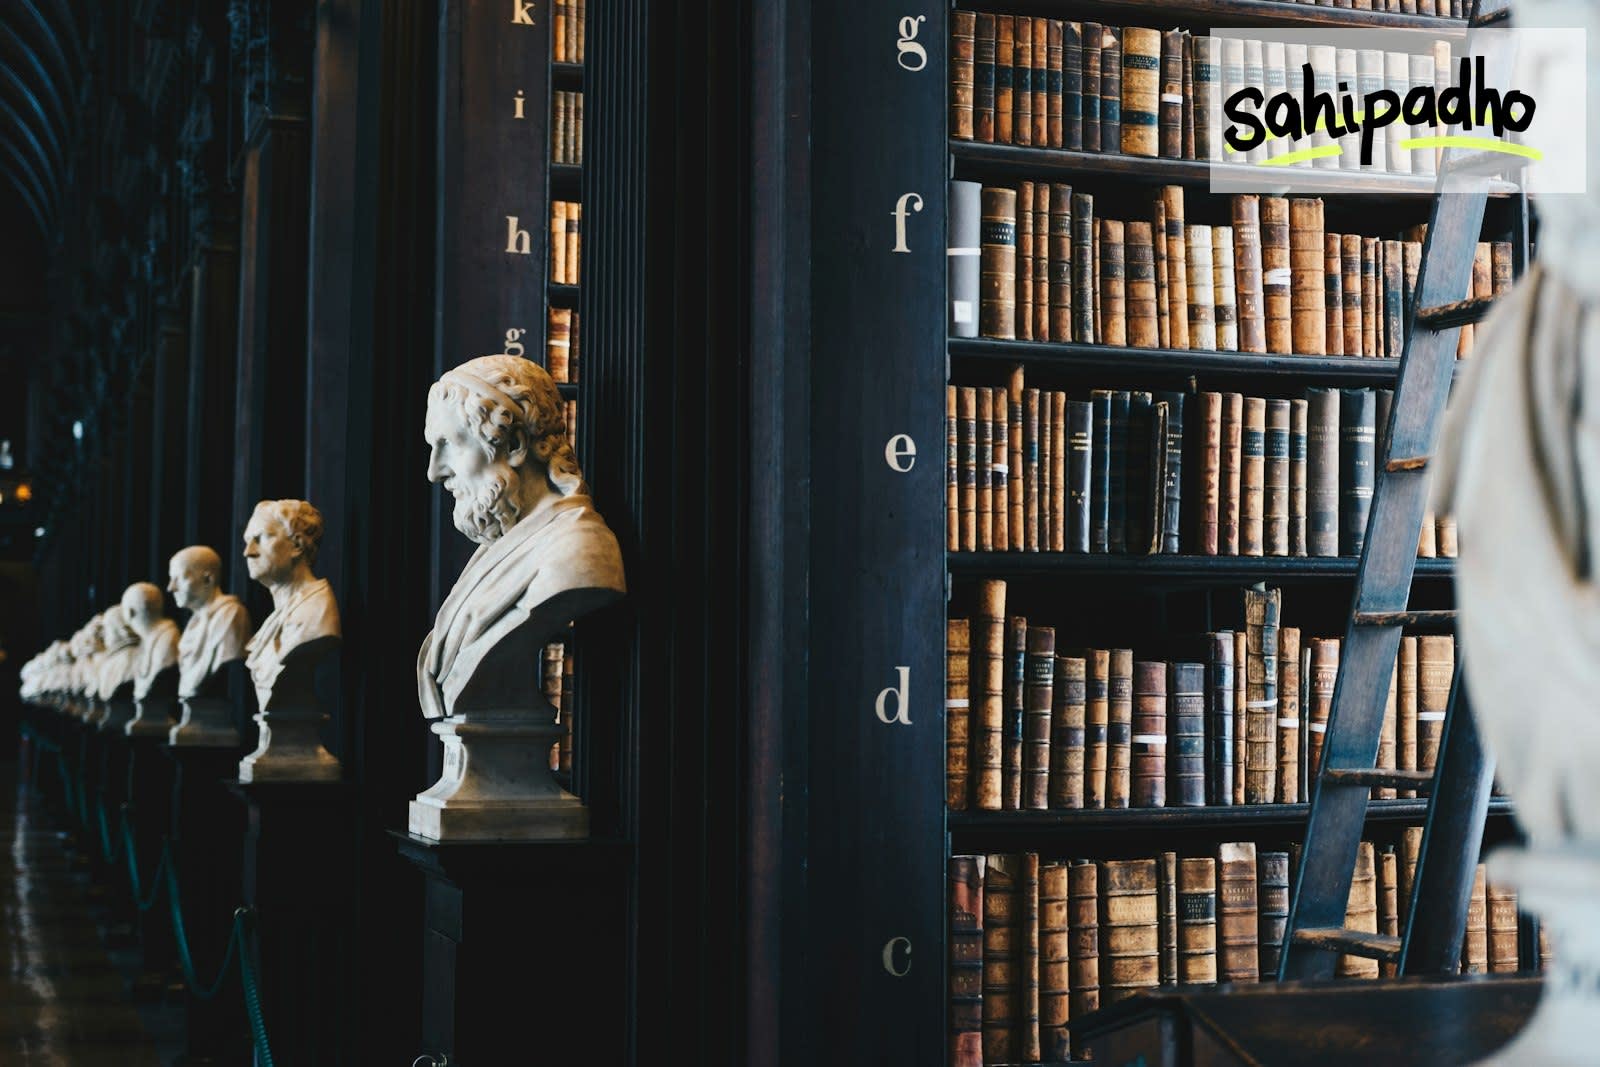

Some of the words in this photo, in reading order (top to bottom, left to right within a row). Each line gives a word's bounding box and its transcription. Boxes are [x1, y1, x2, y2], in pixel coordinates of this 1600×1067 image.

[511, 0, 536, 25] k
[896, 14, 928, 72] g
[513, 90, 525, 119] i
[505, 216, 532, 255] h
[890, 192, 924, 254] f
[504, 328, 526, 356] g
[885, 434, 917, 474] e
[875, 666, 912, 726] d
[883, 936, 912, 977] c
